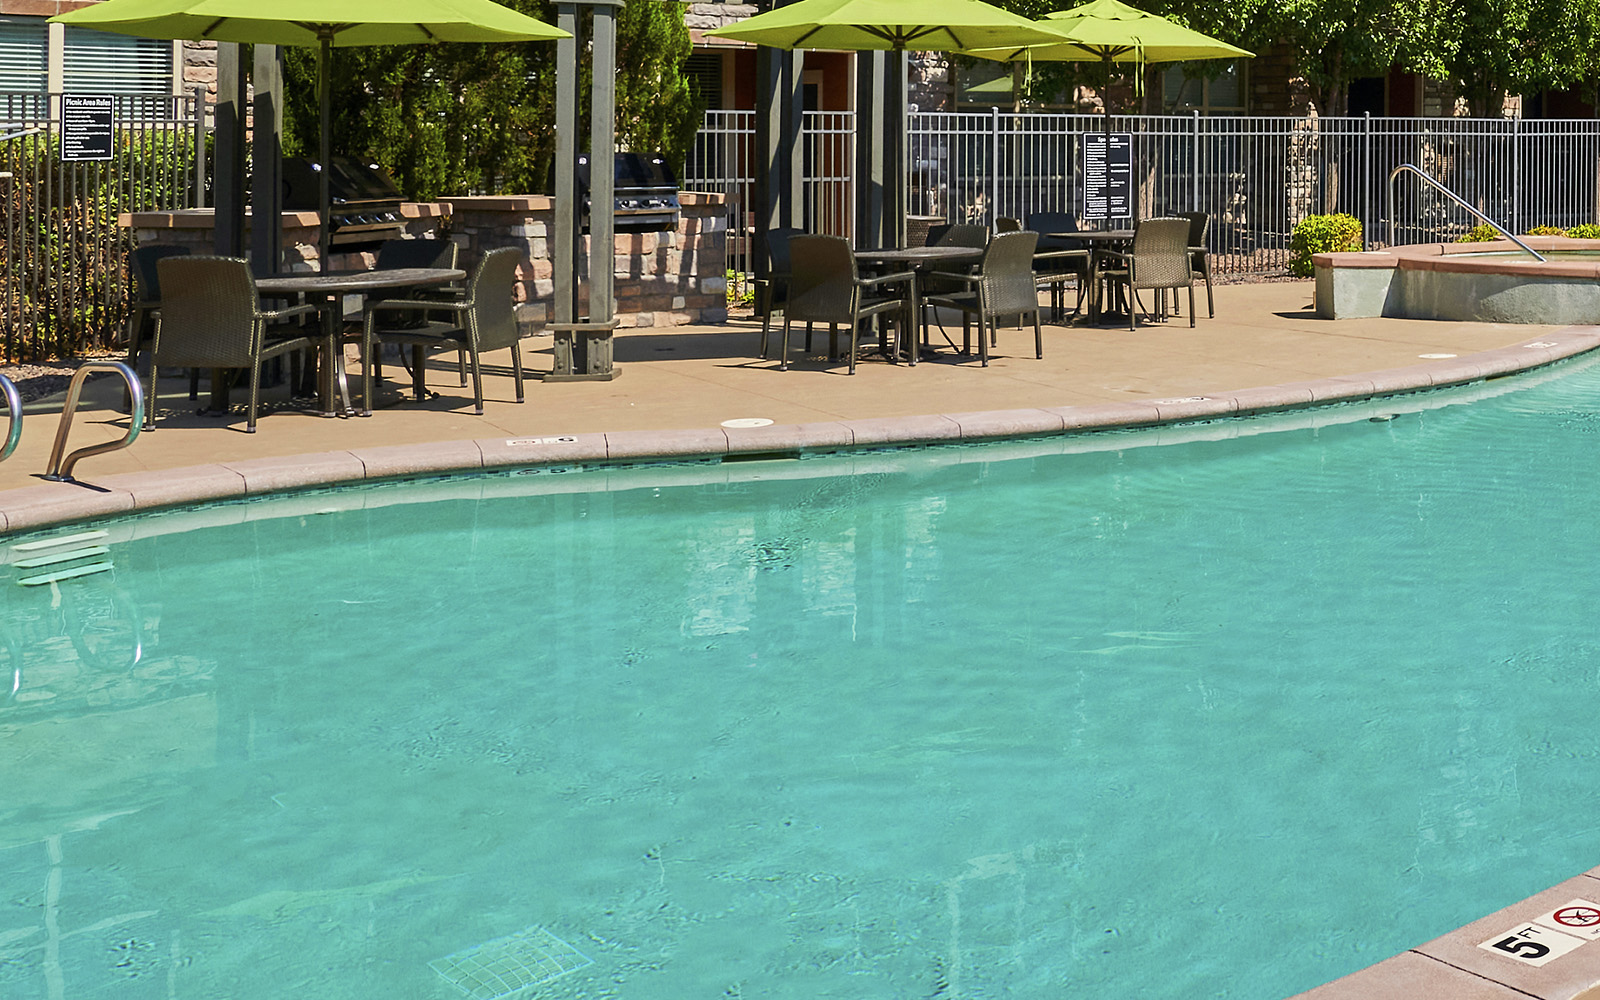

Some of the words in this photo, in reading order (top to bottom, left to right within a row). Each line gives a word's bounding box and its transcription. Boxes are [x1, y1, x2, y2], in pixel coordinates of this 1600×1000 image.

[65, 98, 83, 106] Picnic
[82, 98, 96, 106] Area
[95, 98, 111, 106] Rules
[1516, 926, 1542, 940] FT
[1491, 935, 1551, 959] 5
